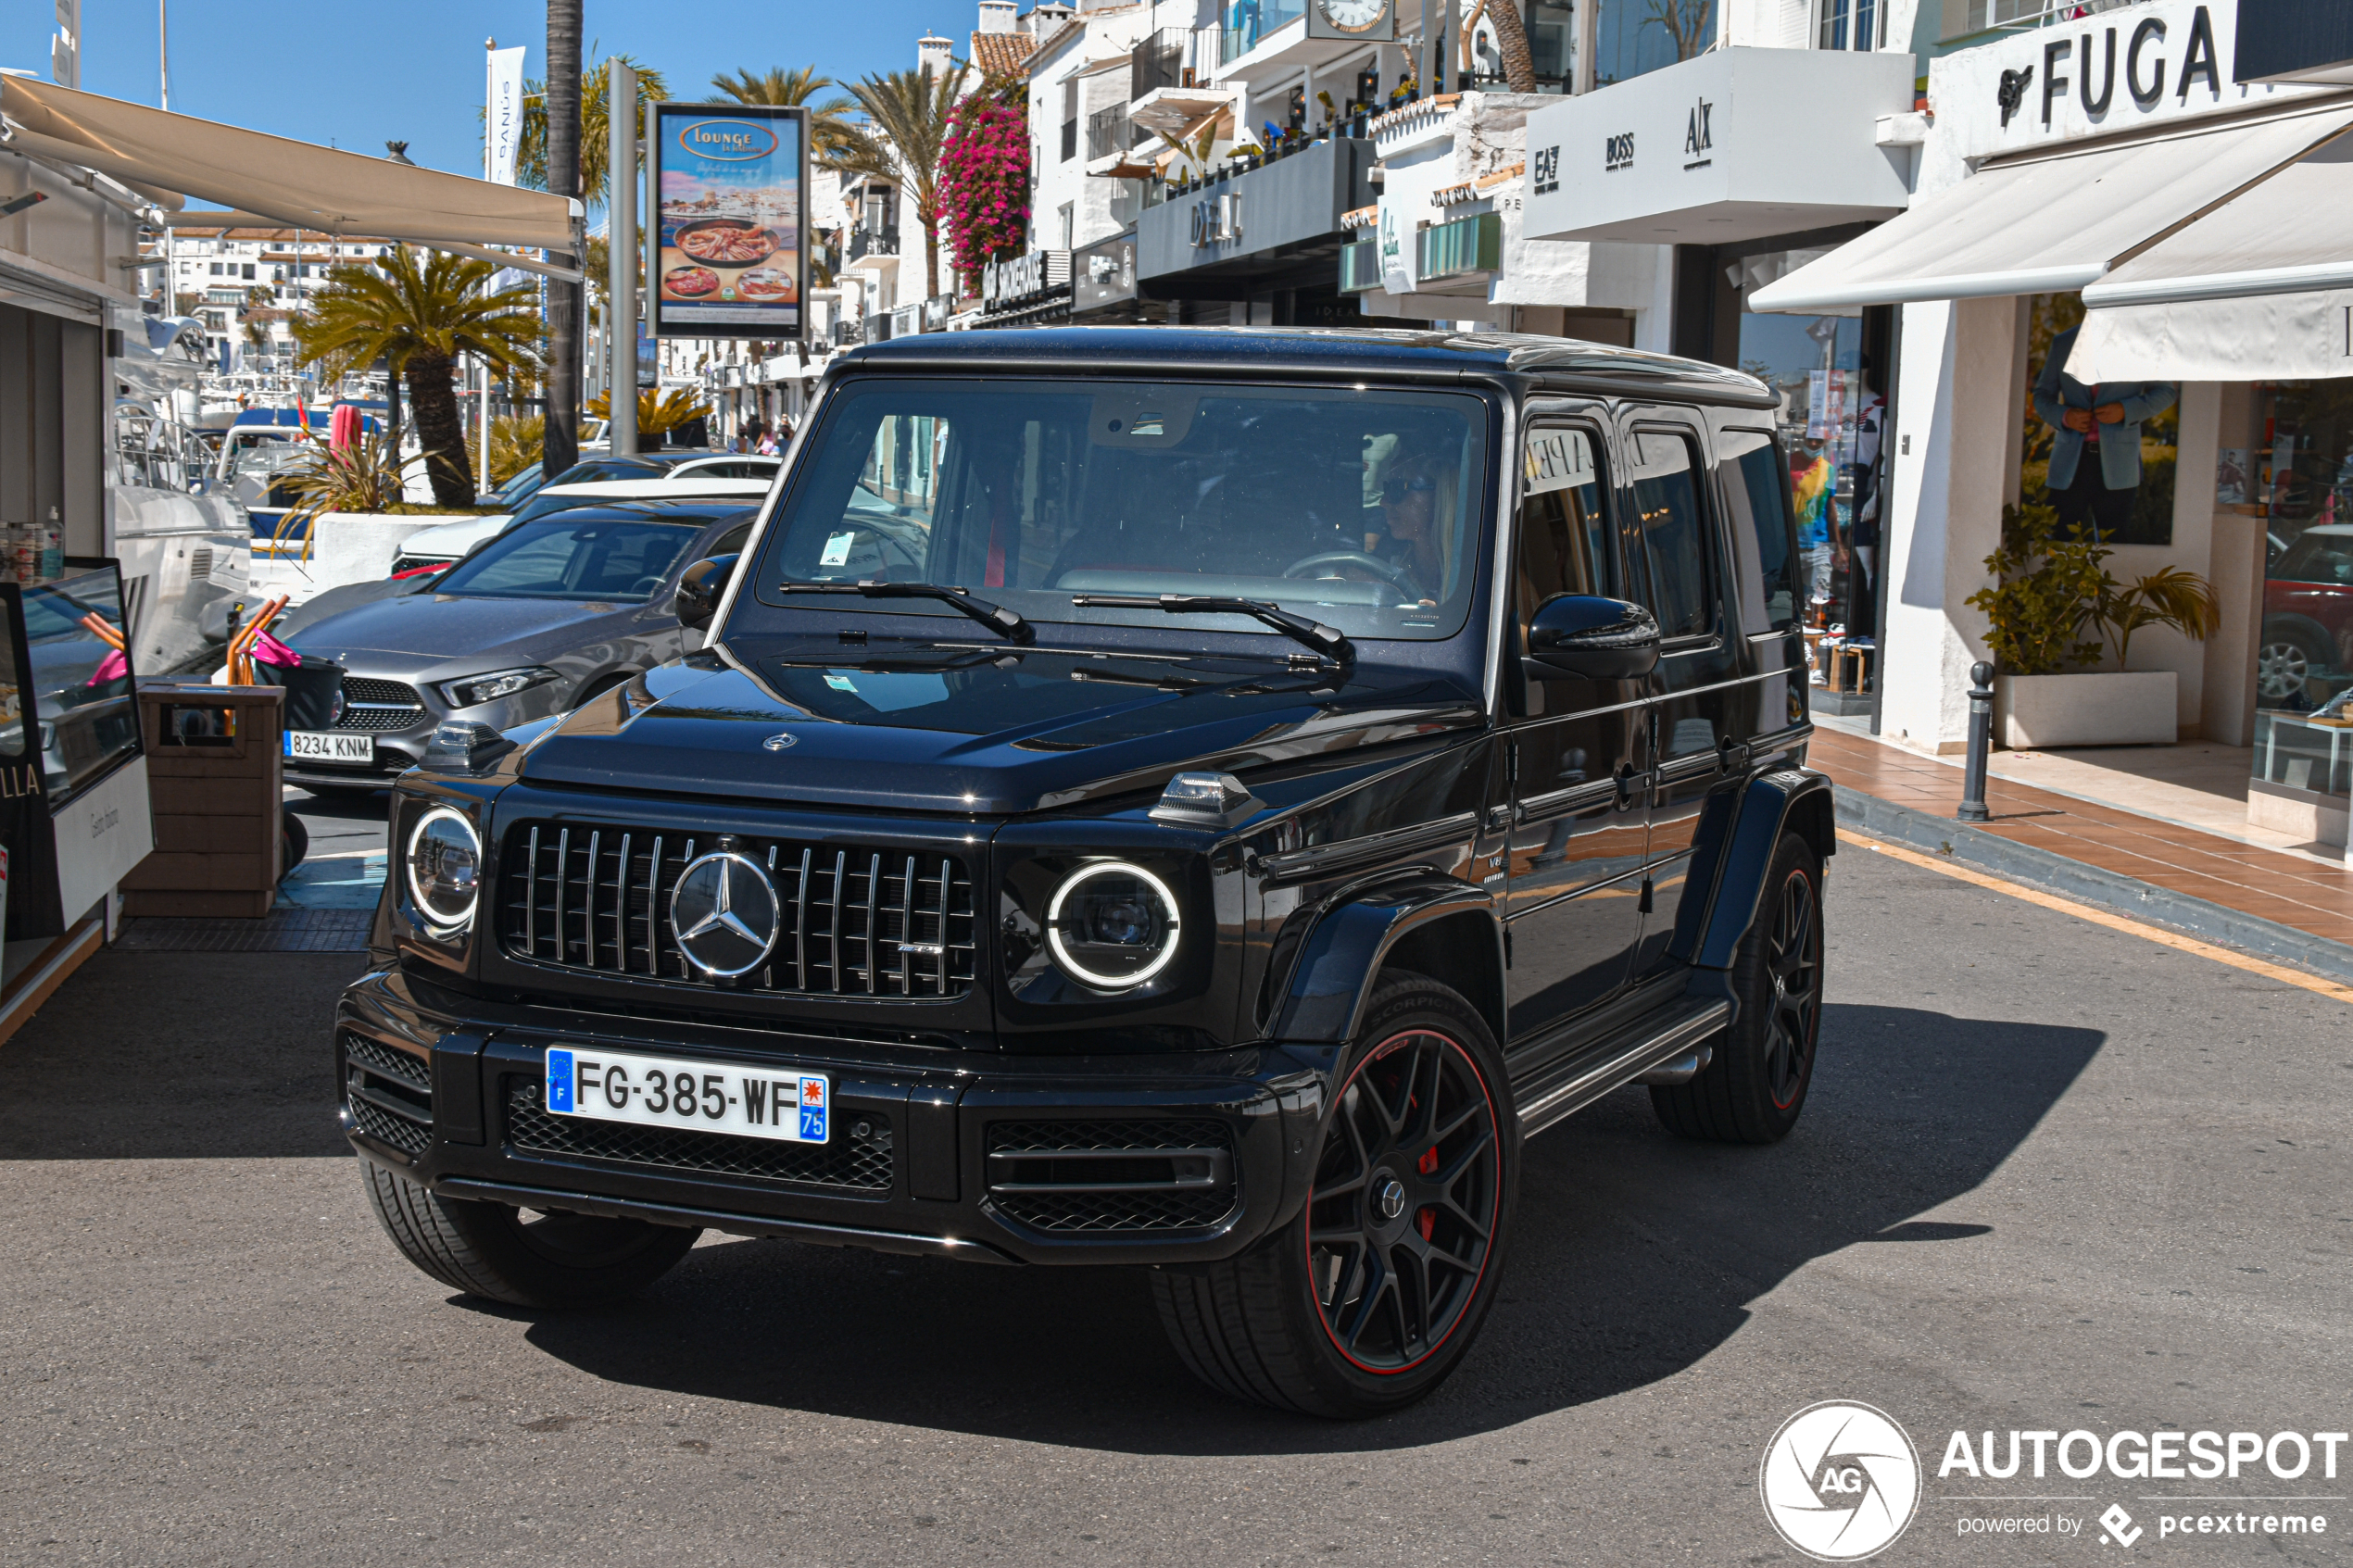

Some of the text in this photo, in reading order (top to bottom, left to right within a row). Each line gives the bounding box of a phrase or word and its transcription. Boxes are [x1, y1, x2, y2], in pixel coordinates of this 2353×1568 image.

[1606, 132, 1634, 164] BOSS
[294, 734, 369, 758] 8234 KNM
[576, 1060, 798, 1126] FG-385-WF
[802, 1111, 824, 1135] 75
